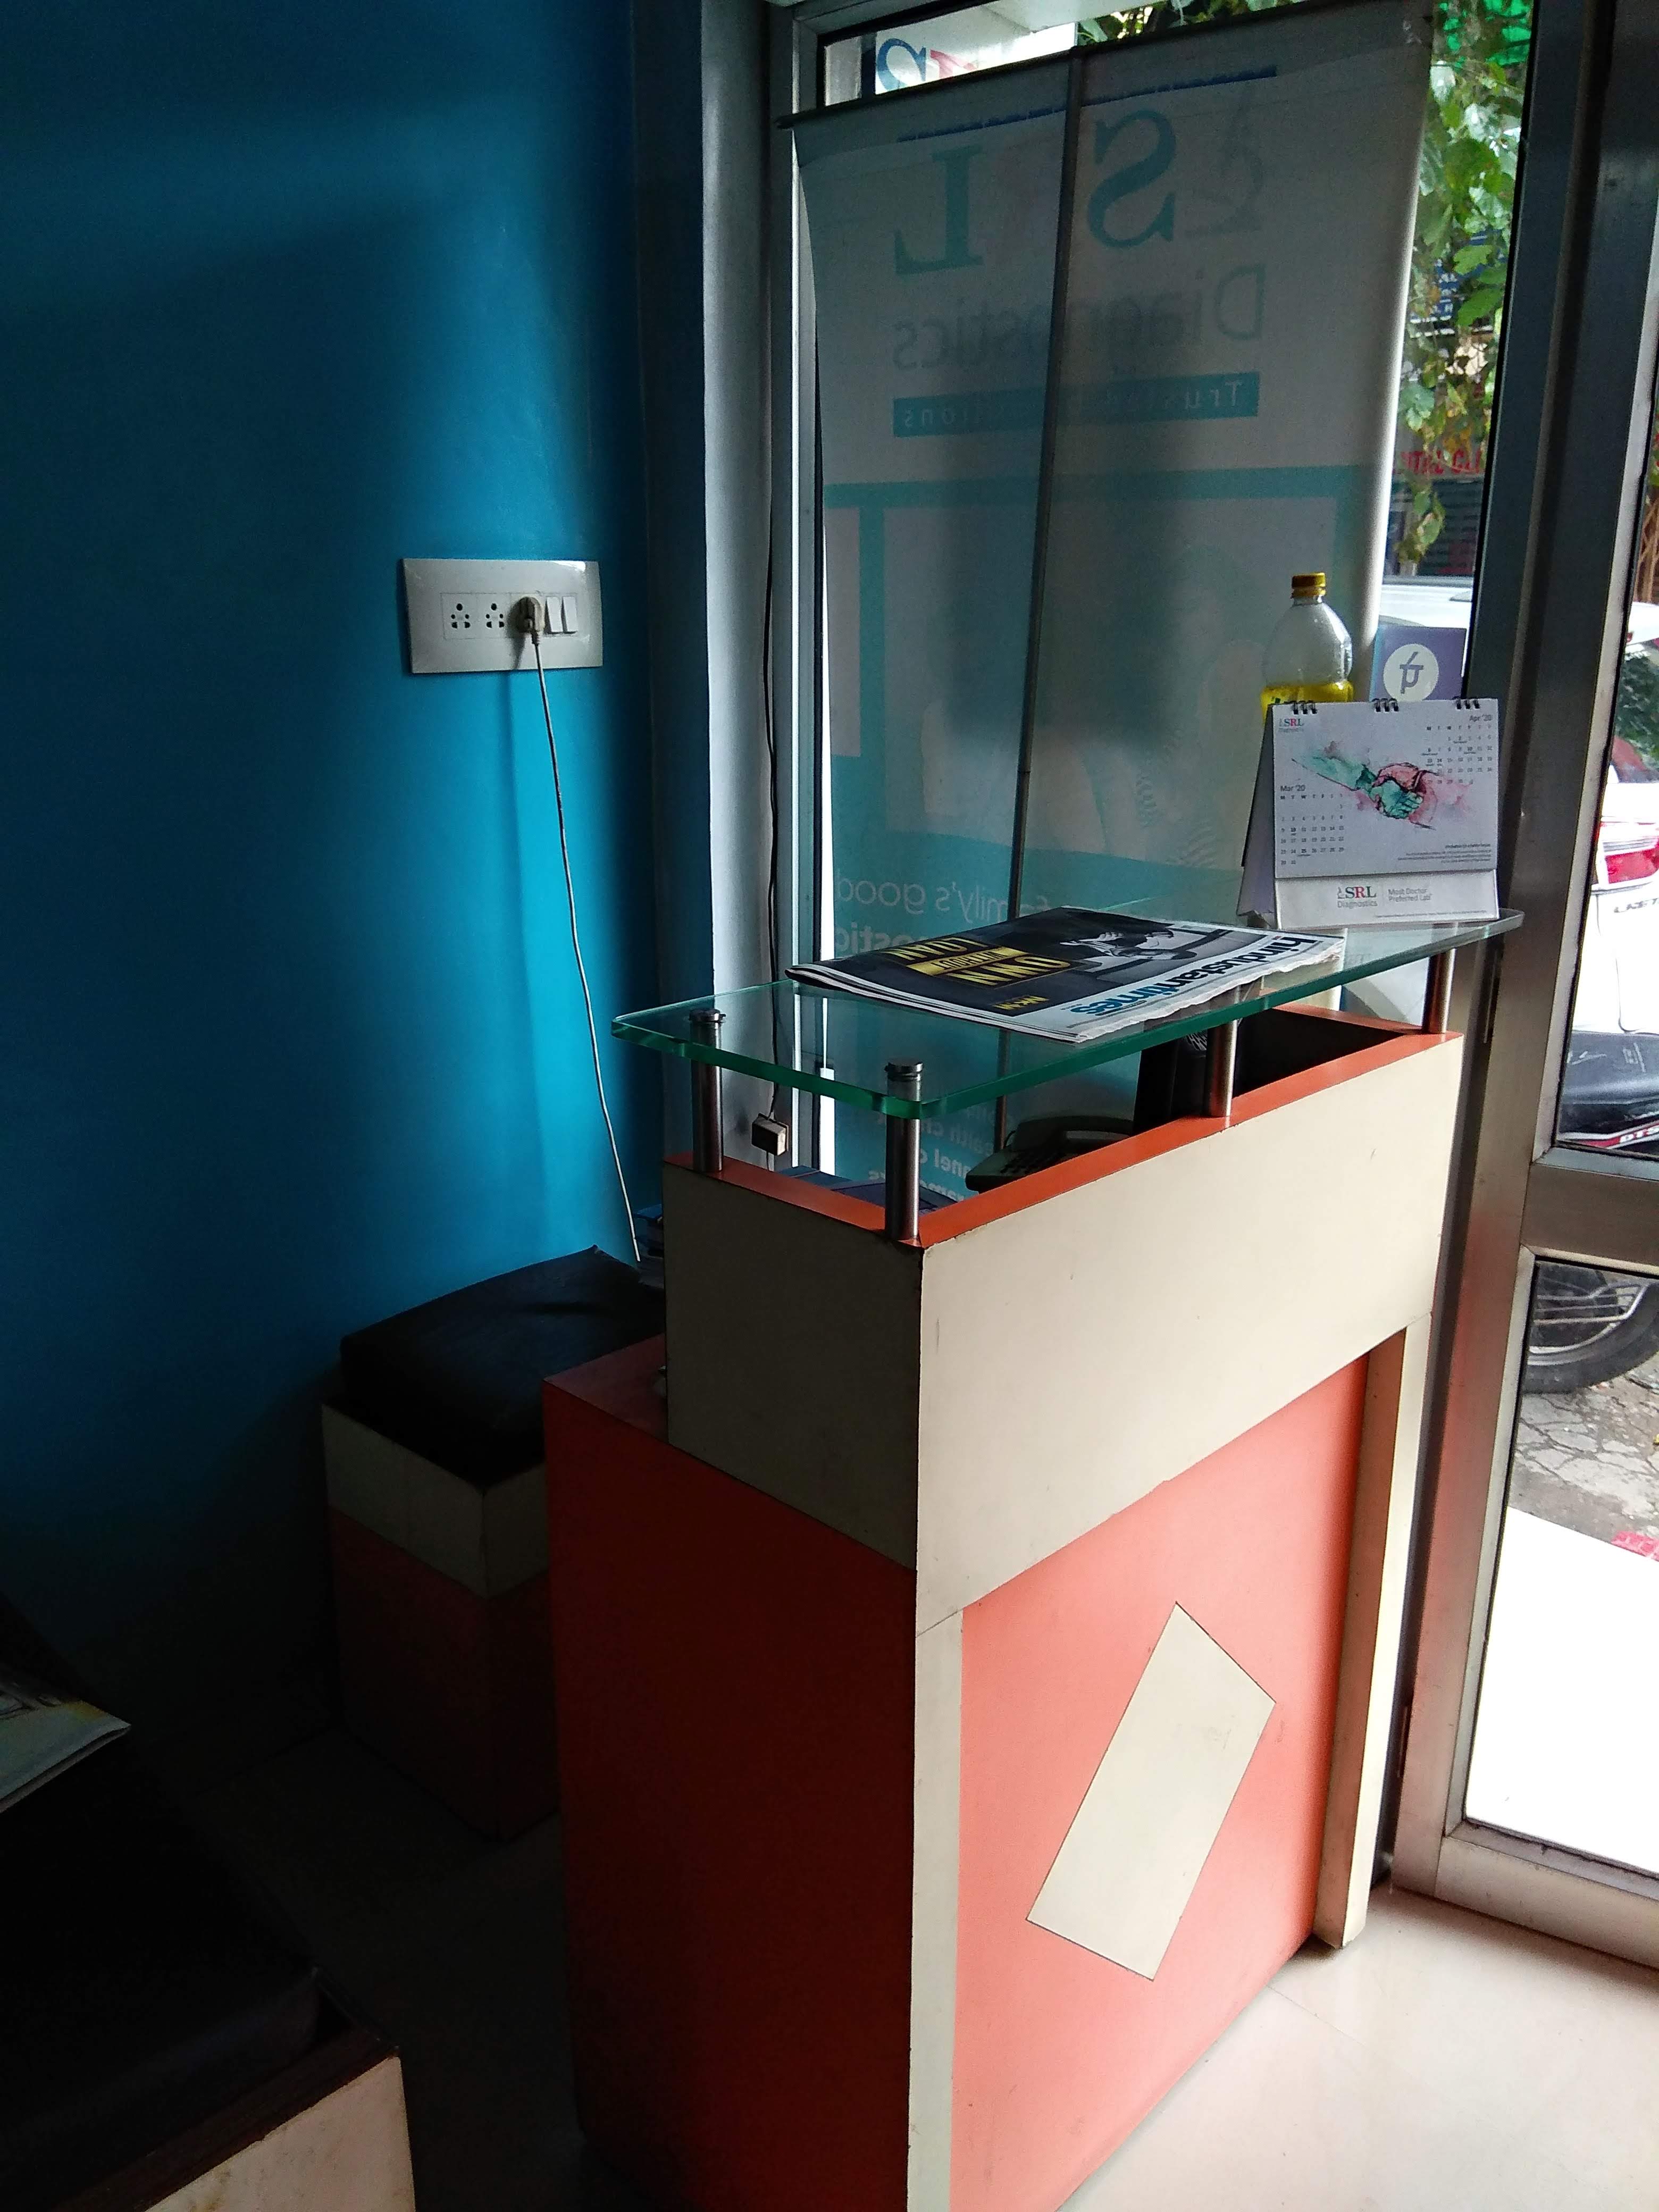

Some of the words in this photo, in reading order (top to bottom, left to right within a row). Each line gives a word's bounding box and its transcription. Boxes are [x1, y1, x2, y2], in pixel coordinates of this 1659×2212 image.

[1284, 718, 1304, 727] SRL
[1345, 886, 1377, 899] SRL
[1337, 901, 1378, 909] Diagnostics
[879, 936, 988, 961] LOAN
[931, 951, 1004, 971] WITHOUT
[945, 957, 1071, 986] OWN
